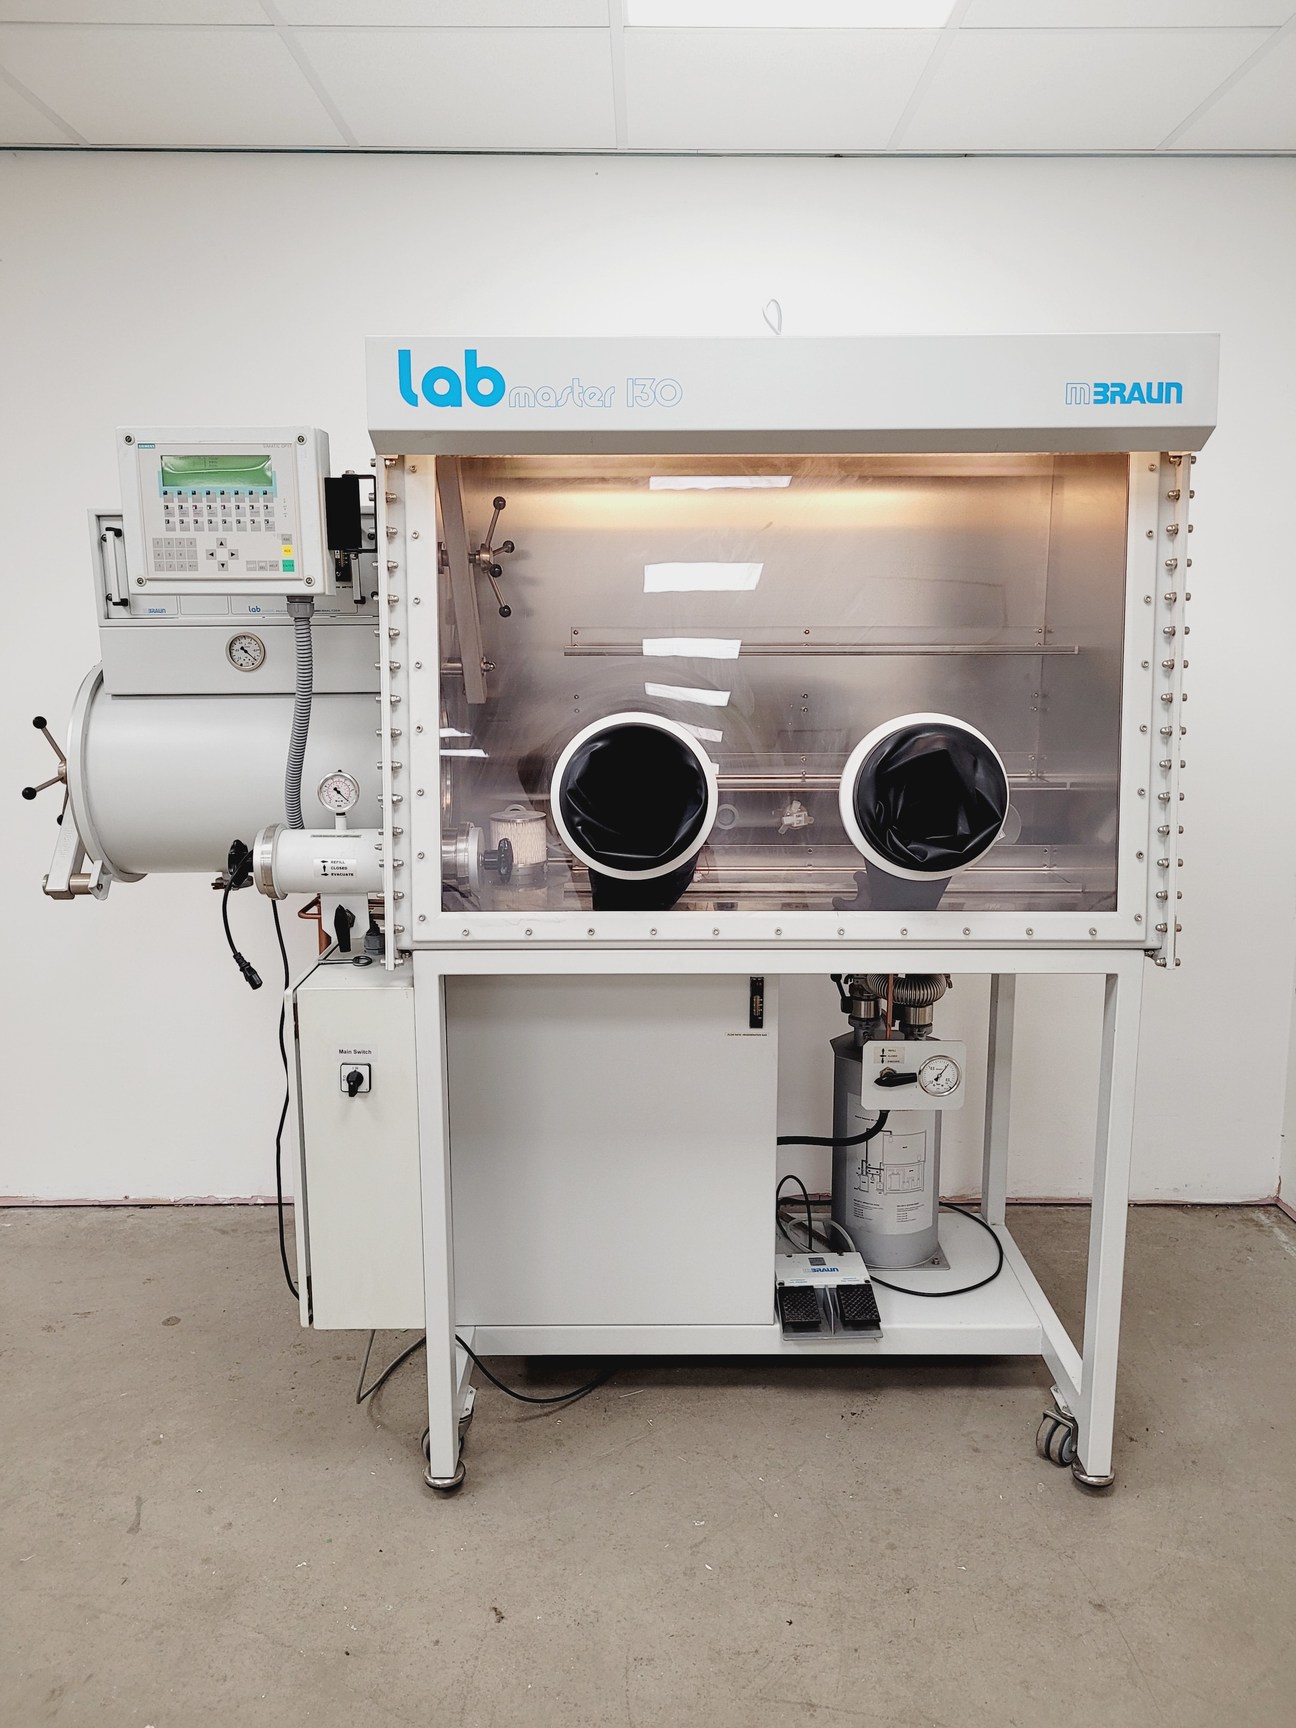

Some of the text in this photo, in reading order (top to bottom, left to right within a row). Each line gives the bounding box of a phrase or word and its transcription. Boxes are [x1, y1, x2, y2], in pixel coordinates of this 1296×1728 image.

[398, 349, 684, 408] lab master 130
